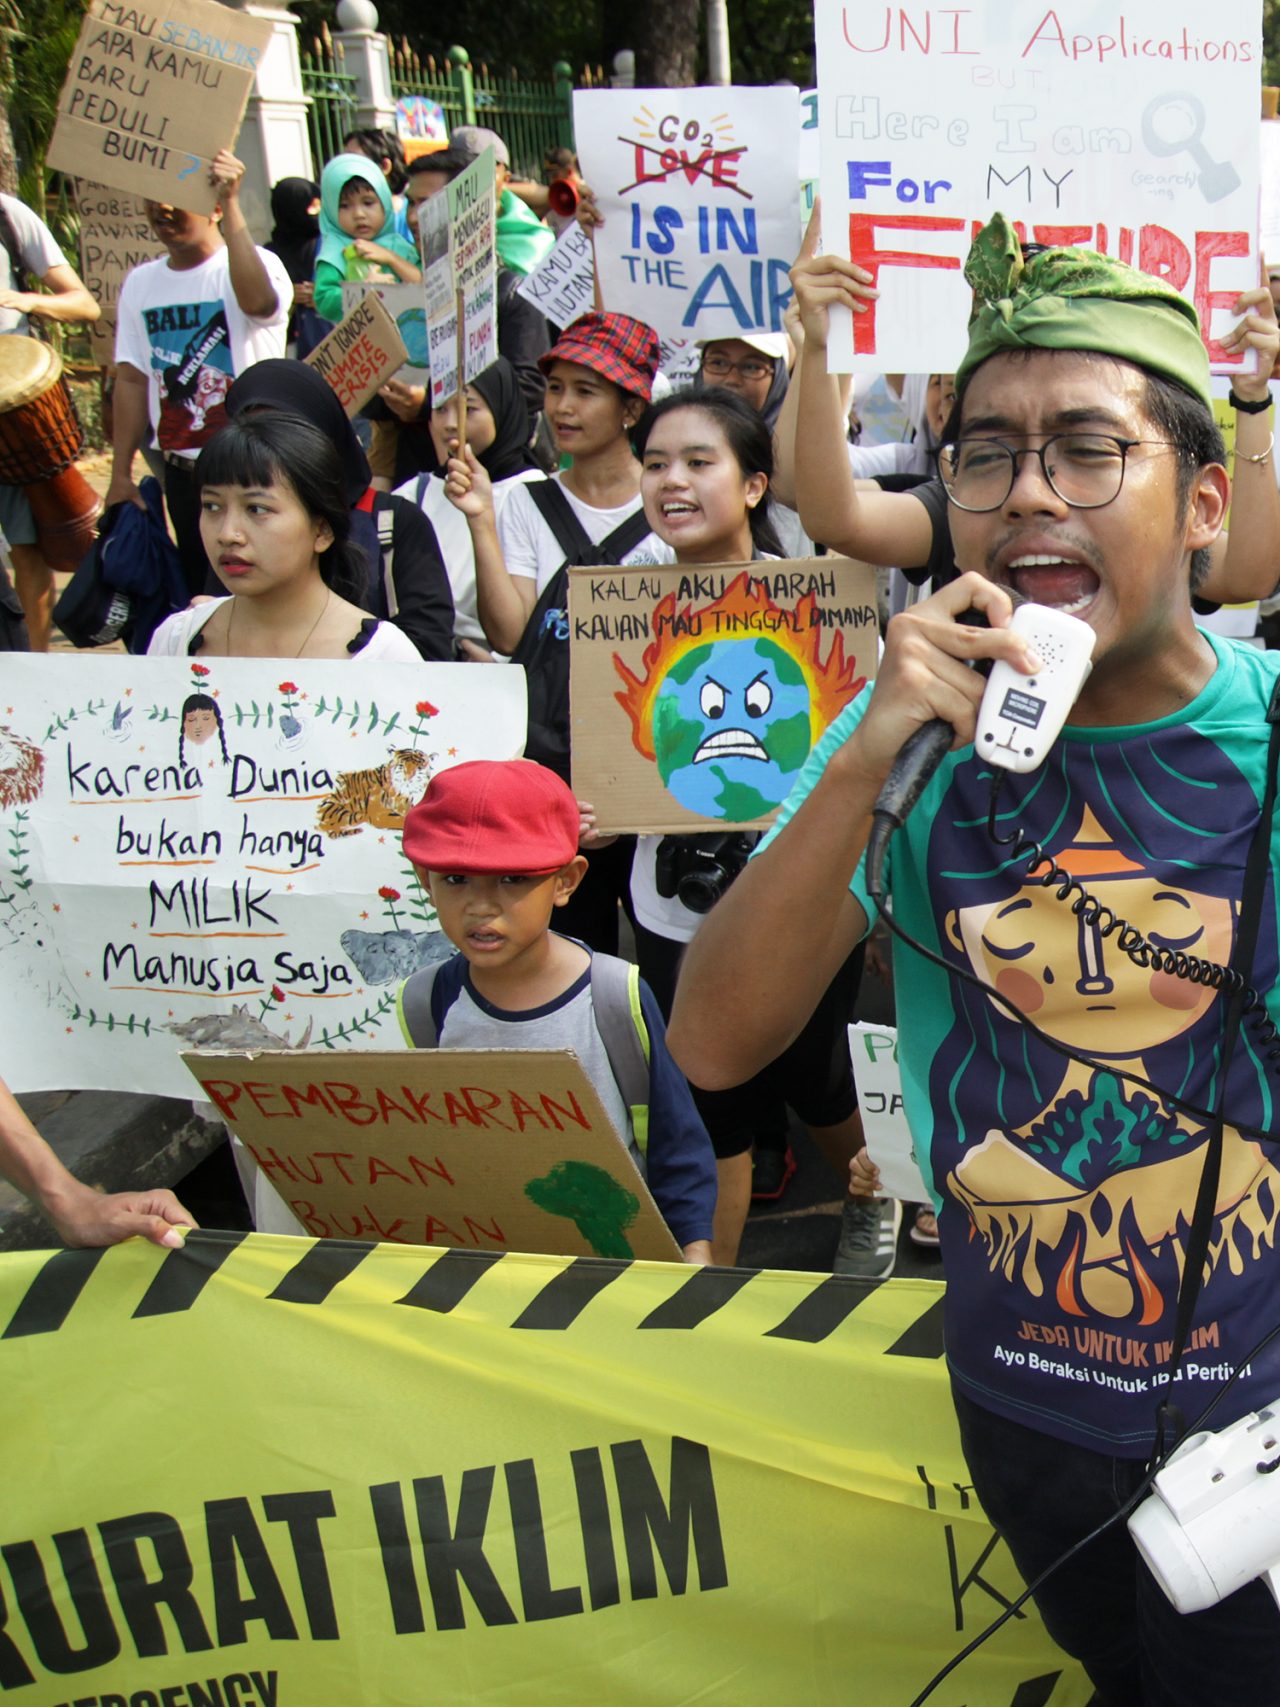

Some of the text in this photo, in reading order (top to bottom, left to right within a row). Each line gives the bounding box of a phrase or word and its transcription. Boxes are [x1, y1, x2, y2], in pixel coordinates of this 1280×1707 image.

[100, 3, 260, 69] MAU SEBANJIR
[842, 6, 980, 54] UNI
[77, 56, 149, 96] BARU
[88, 31, 223, 88] APA KAMU
[69, 88, 170, 141] PEDULI
[834, 95, 970, 147] Here
[993, 104, 1037, 153] I
[1051, 125, 1132, 155] am
[103, 131, 201, 180] BUMI ?
[634, 145, 742, 187] LOVE
[847, 161, 953, 203] For
[987, 164, 1073, 208] MY
[630, 202, 759, 255] IS IN
[526, 248, 573, 302] KAMU
[621, 255, 794, 333] THE AIR
[145, 303, 201, 335] BALI
[333, 301, 375, 354] IGNORE
[326, 333, 374, 390] LIMATE
[338, 347, 389, 407] CRISIS
[590, 571, 836, 602] KALAU AKU MARAH
[575, 613, 649, 641] KALIAN
[658, 614, 702, 637] MAU
[711, 609, 805, 634] TINGGAL
[809, 605, 878, 628] DIMANA
[227, 754, 334, 799] Dunia
[116, 814, 325, 868] bukan hanya
[149, 877, 279, 929] MILIK
[103, 942, 353, 993] Manusia Saja
[863, 1033, 899, 1064] P
[202, 1079, 593, 1133] PEMBAKARAN
[246, 1142, 455, 1188] HUTAN
[994, 1344, 1026, 1368] Ayo
[1028, 1352, 1091, 1383] Beraksi
[1092, 1370, 1149, 1394] Untuk
[1017, 1319, 1220, 1368] JEDA UNTUK IKIM
[369, 1435, 729, 1636] IKLIM
